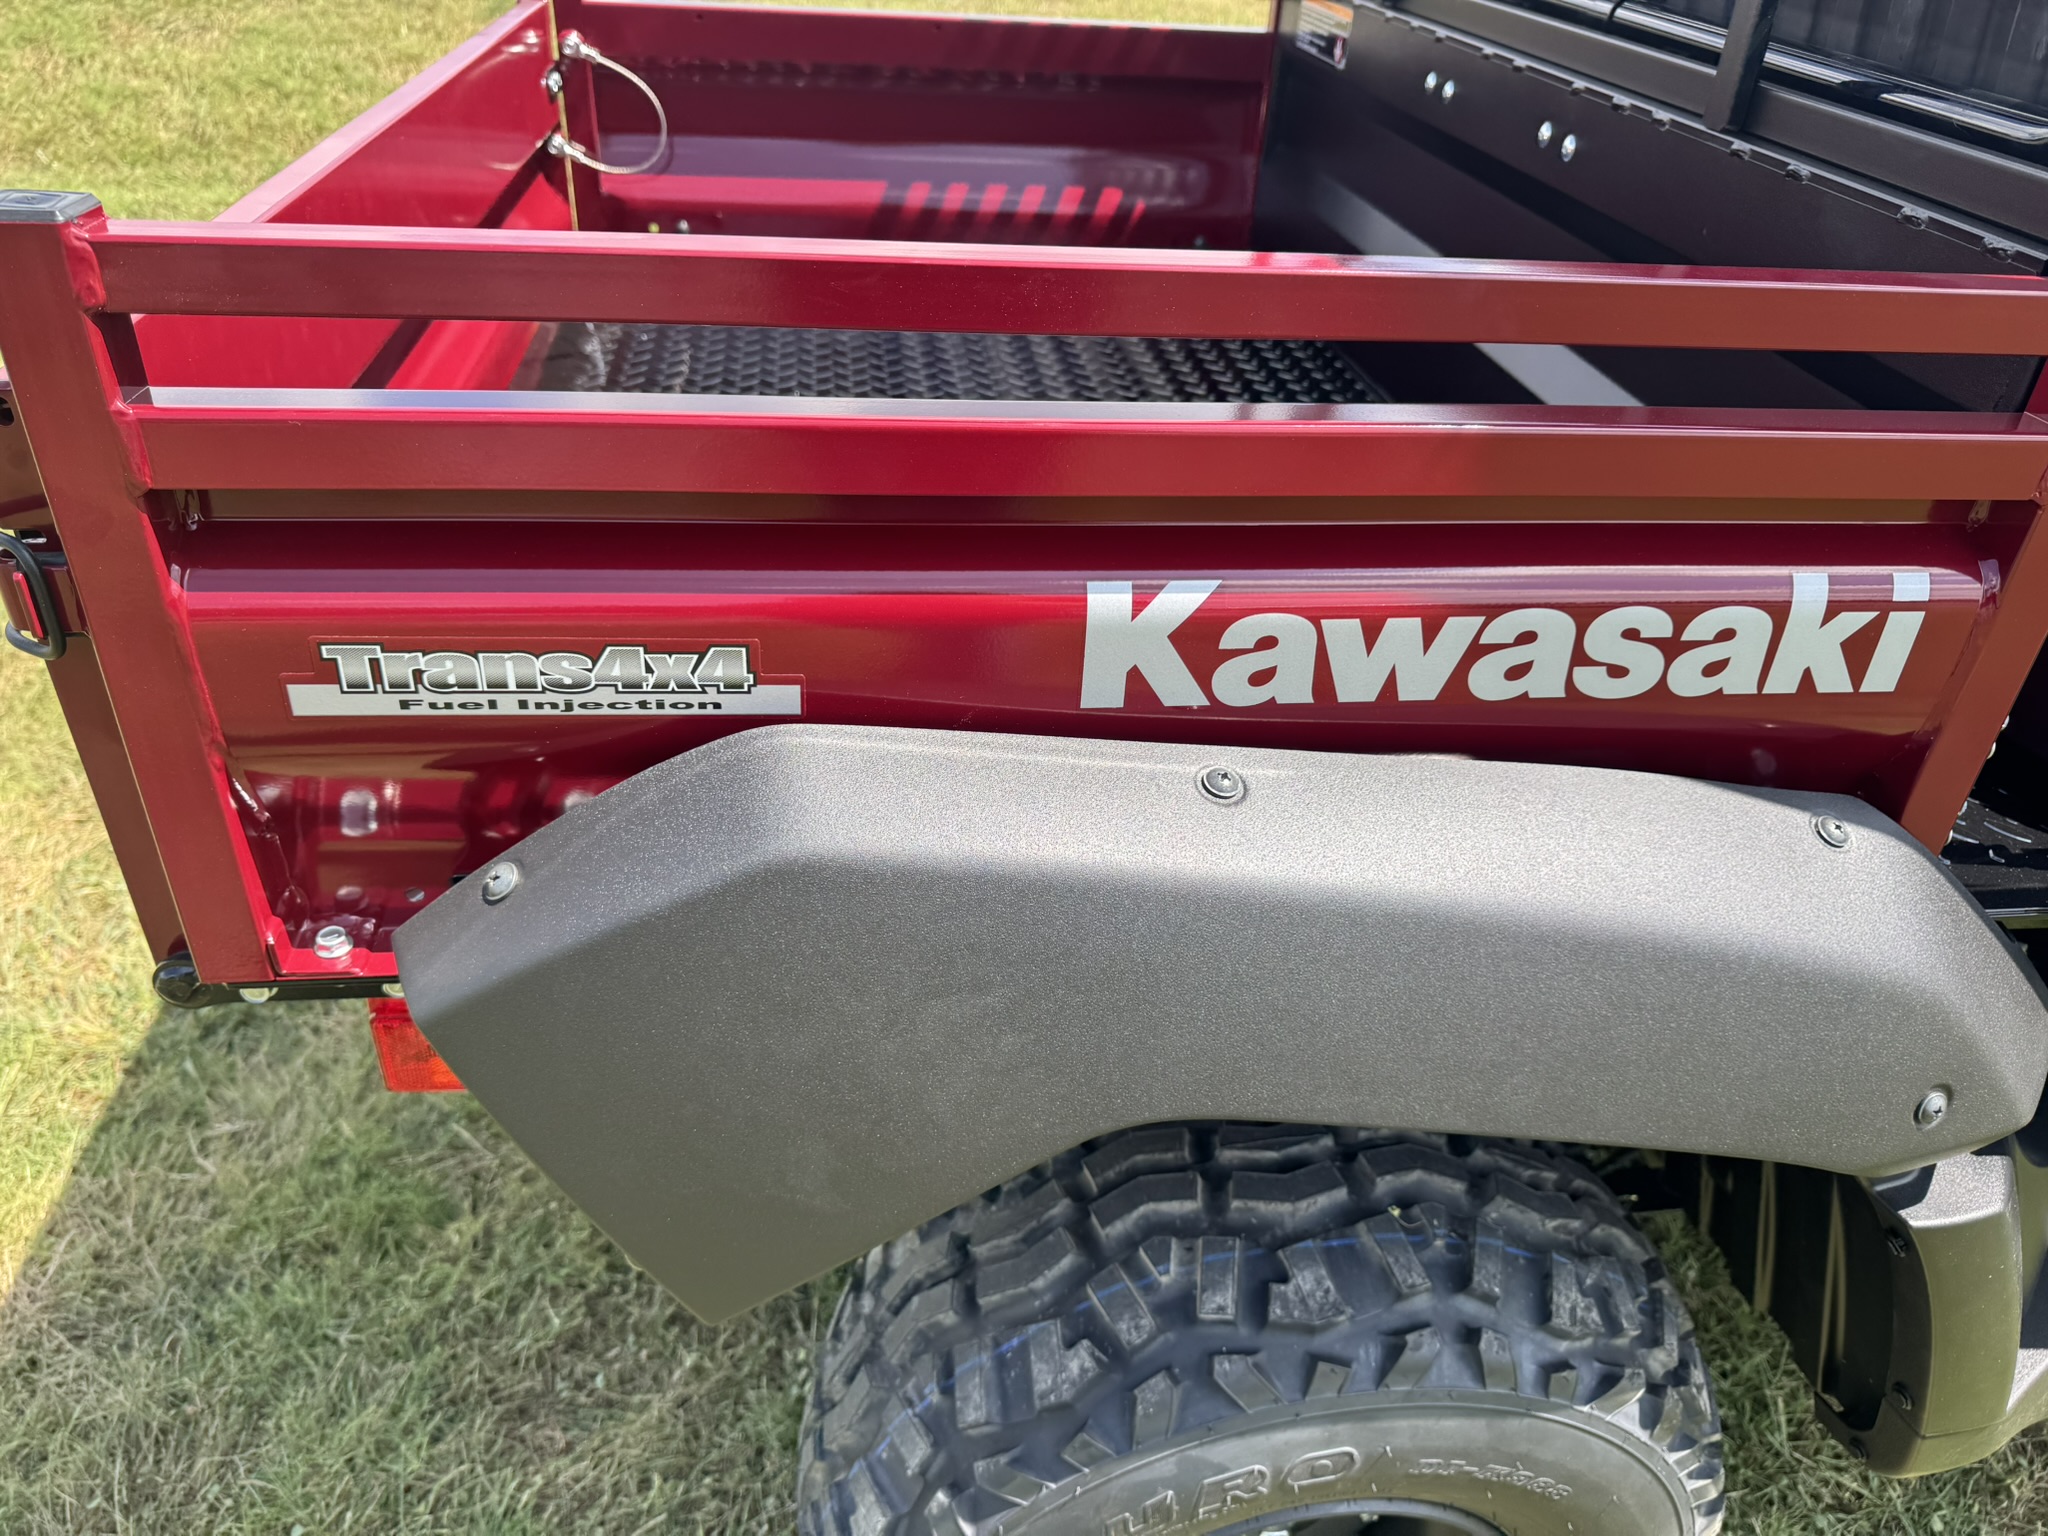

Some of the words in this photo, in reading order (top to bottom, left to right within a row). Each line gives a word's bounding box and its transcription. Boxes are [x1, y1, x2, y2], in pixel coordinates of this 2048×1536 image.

[1080, 571, 1931, 709] Kawasaki
[317, 642, 757, 693] Trans4x4
[399, 699, 498, 711] Fuel
[517, 699, 723, 713] Injection
